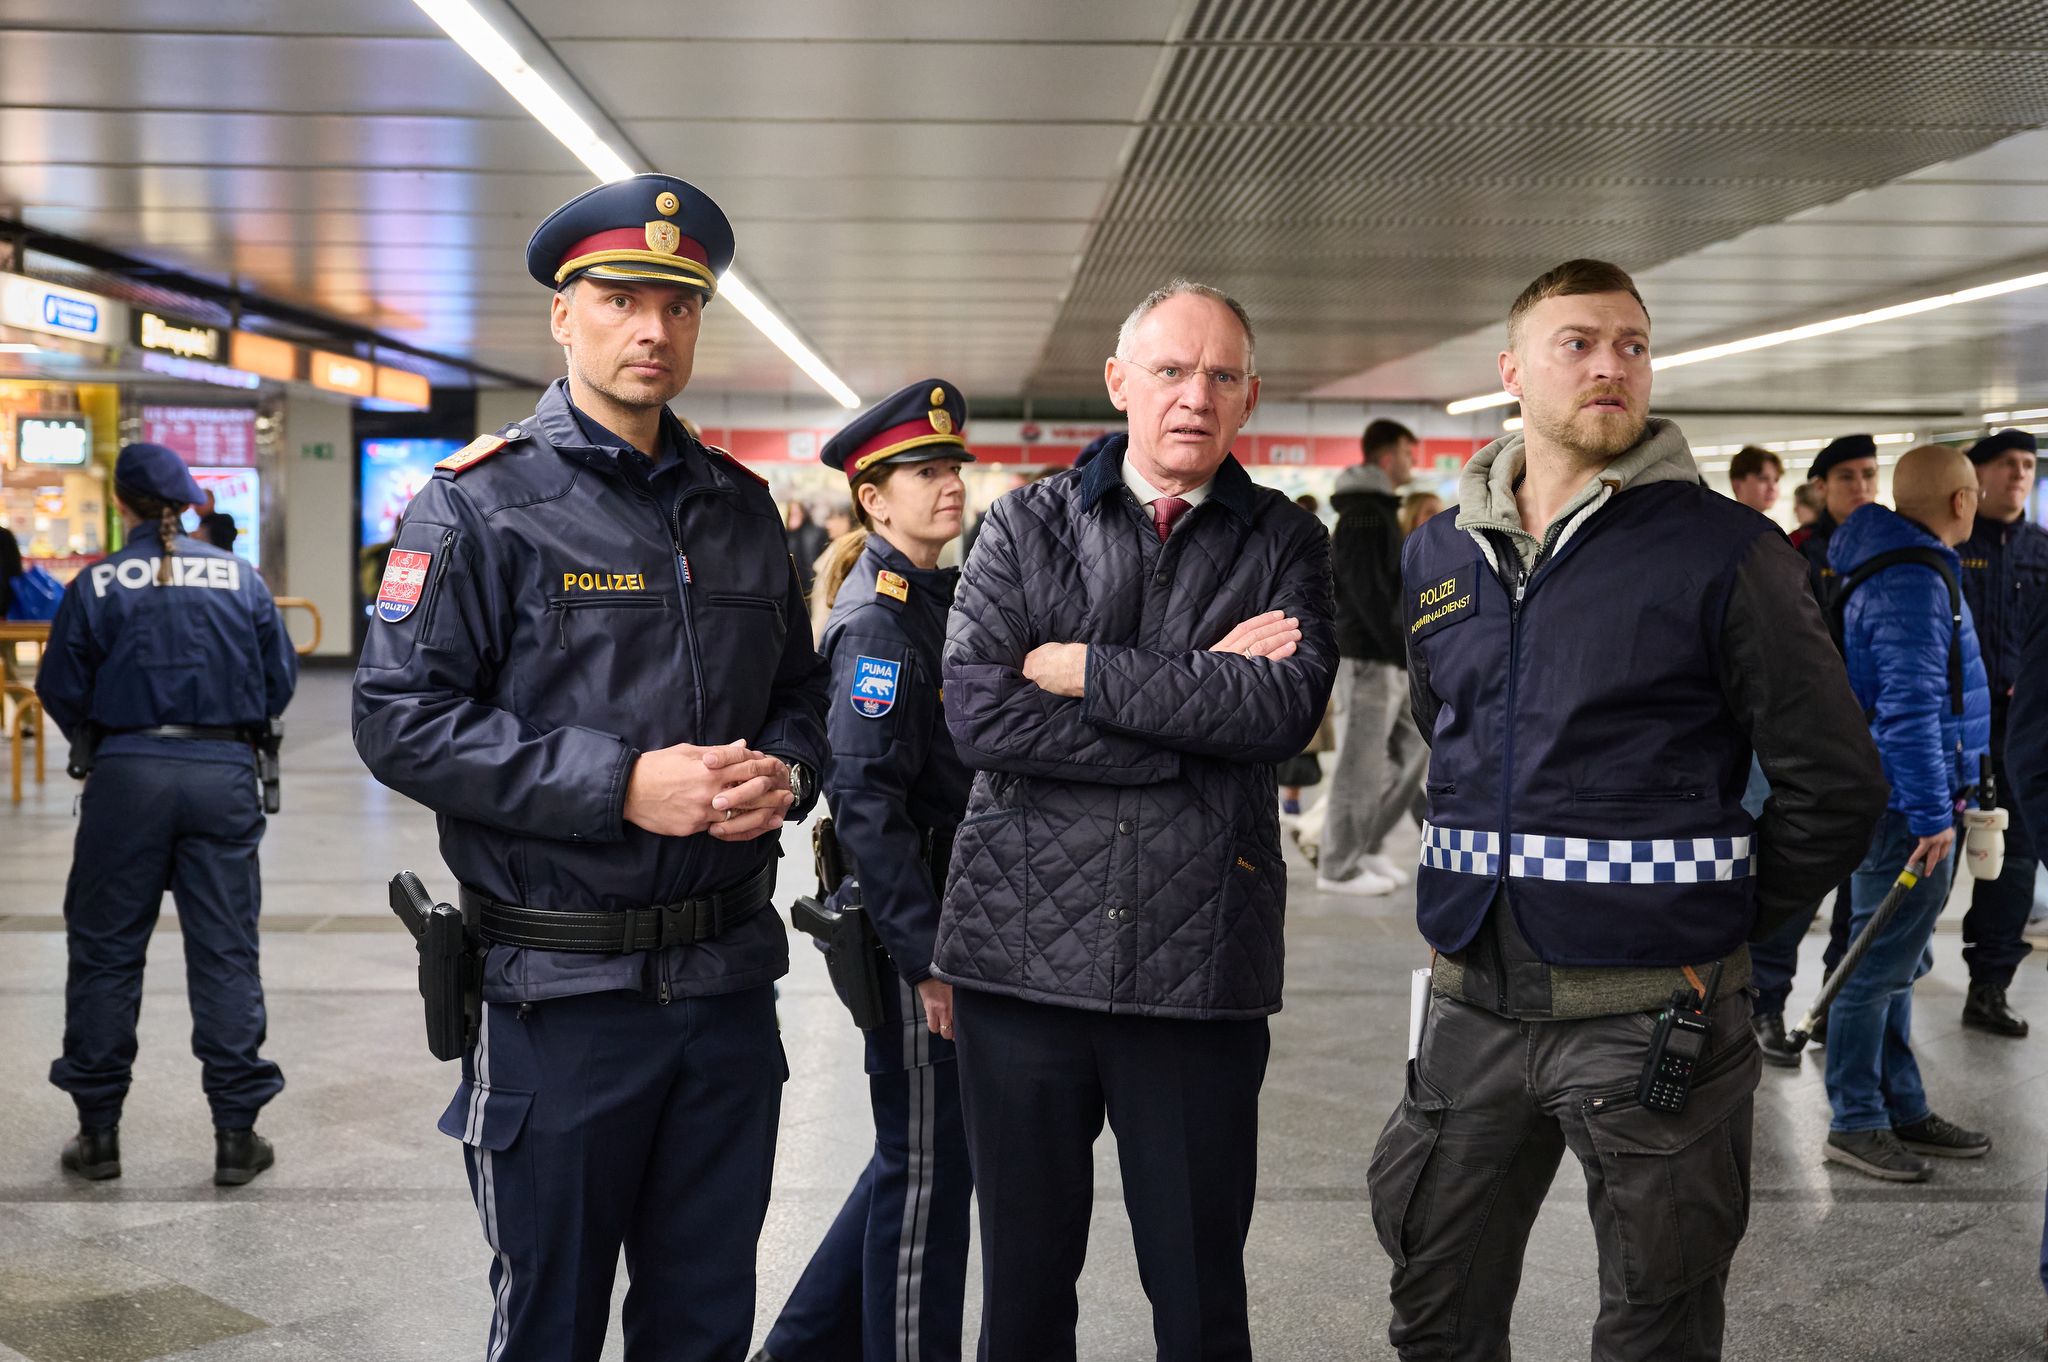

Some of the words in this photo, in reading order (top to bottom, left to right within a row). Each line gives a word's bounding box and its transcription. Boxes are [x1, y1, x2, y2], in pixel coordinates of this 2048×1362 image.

[91, 557, 240, 598] POLIZEI
[563, 573, 646, 592] POLIZEI
[1420, 578, 1456, 609] POLIZEI
[380, 601, 410, 613] POLIZEI
[1411, 594, 1471, 635] KRIMINALDIENST
[861, 662, 893, 678] PUMA
